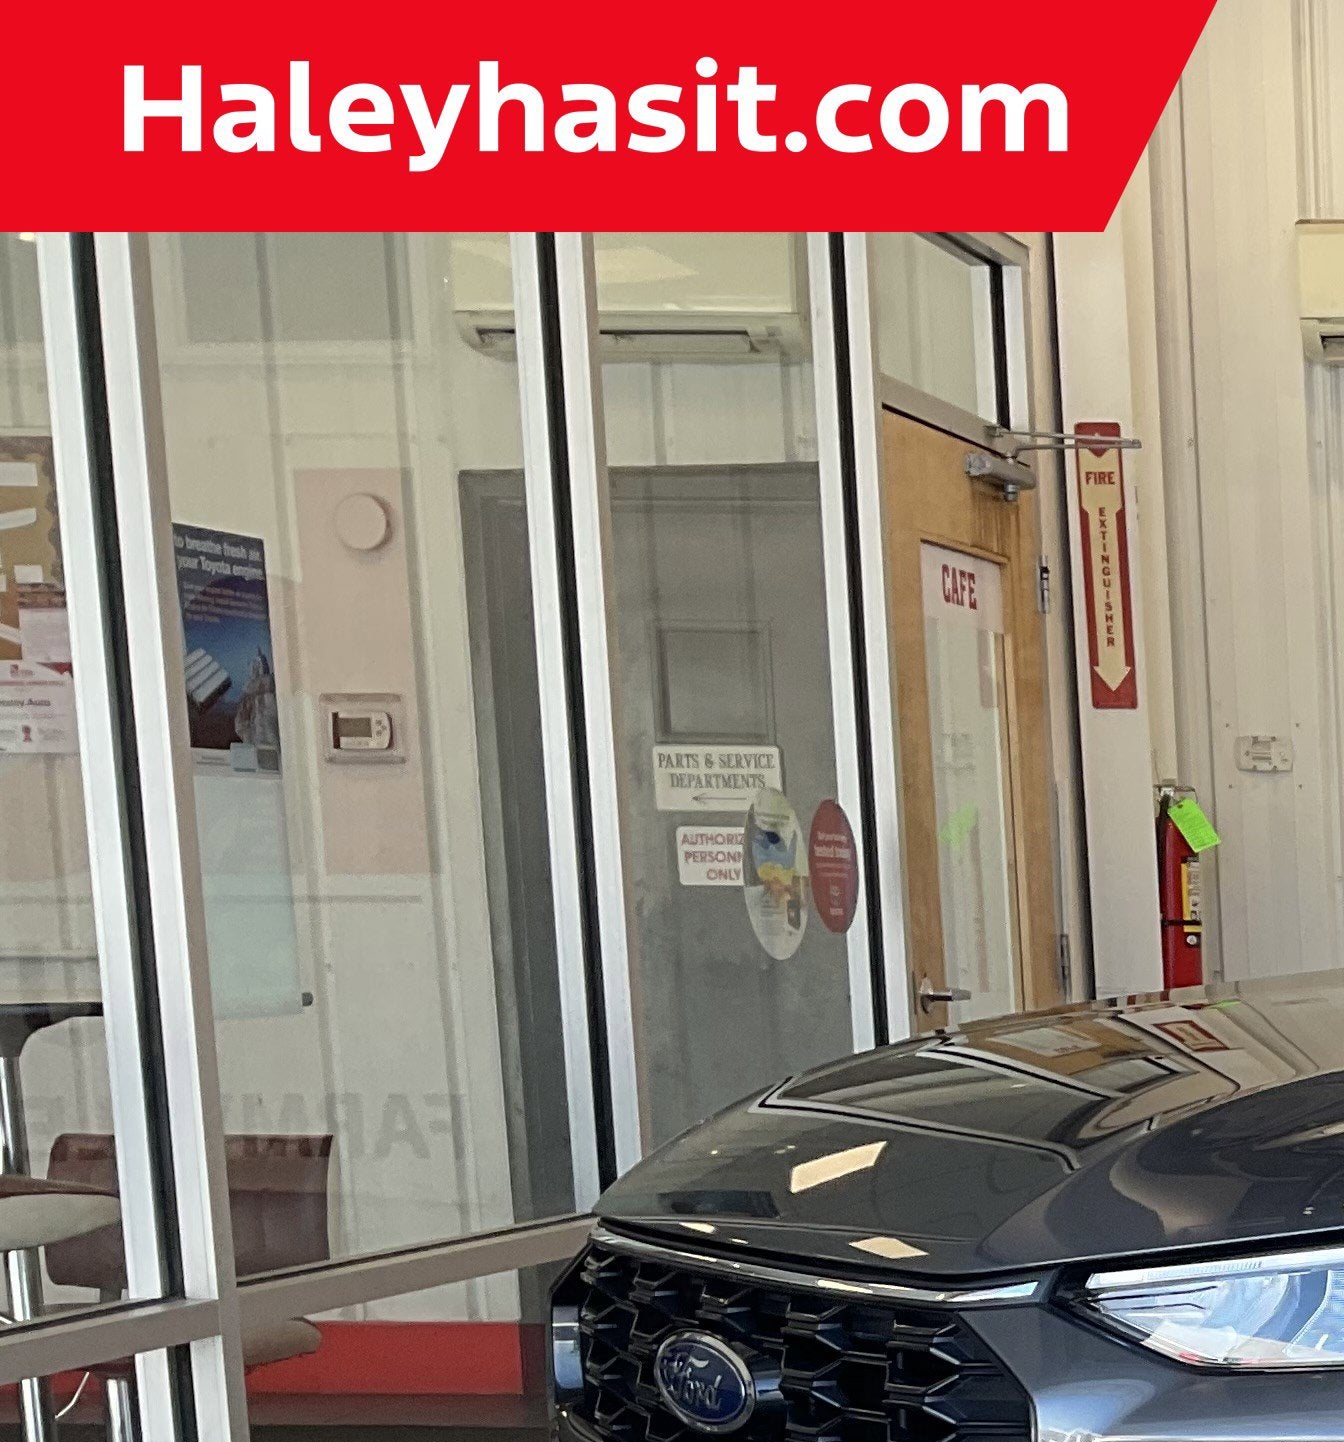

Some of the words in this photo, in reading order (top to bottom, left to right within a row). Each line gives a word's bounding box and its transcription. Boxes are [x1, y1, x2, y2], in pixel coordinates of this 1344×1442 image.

[1085, 471, 1116, 485] FIRE
[1098, 507, 1116, 648] EXTINGUISHER
[941, 564, 977, 610] CAFE
[658, 753, 699, 768] PARTS
[704, 754, 714, 768] &
[718, 753, 775, 769] SERVICE
[670, 773, 766, 789] DEPARTMENTS
[681, 833, 744, 846] AUTHORIZ
[684, 851, 744, 864] PERSON
[706, 870, 742, 881] ONLY
